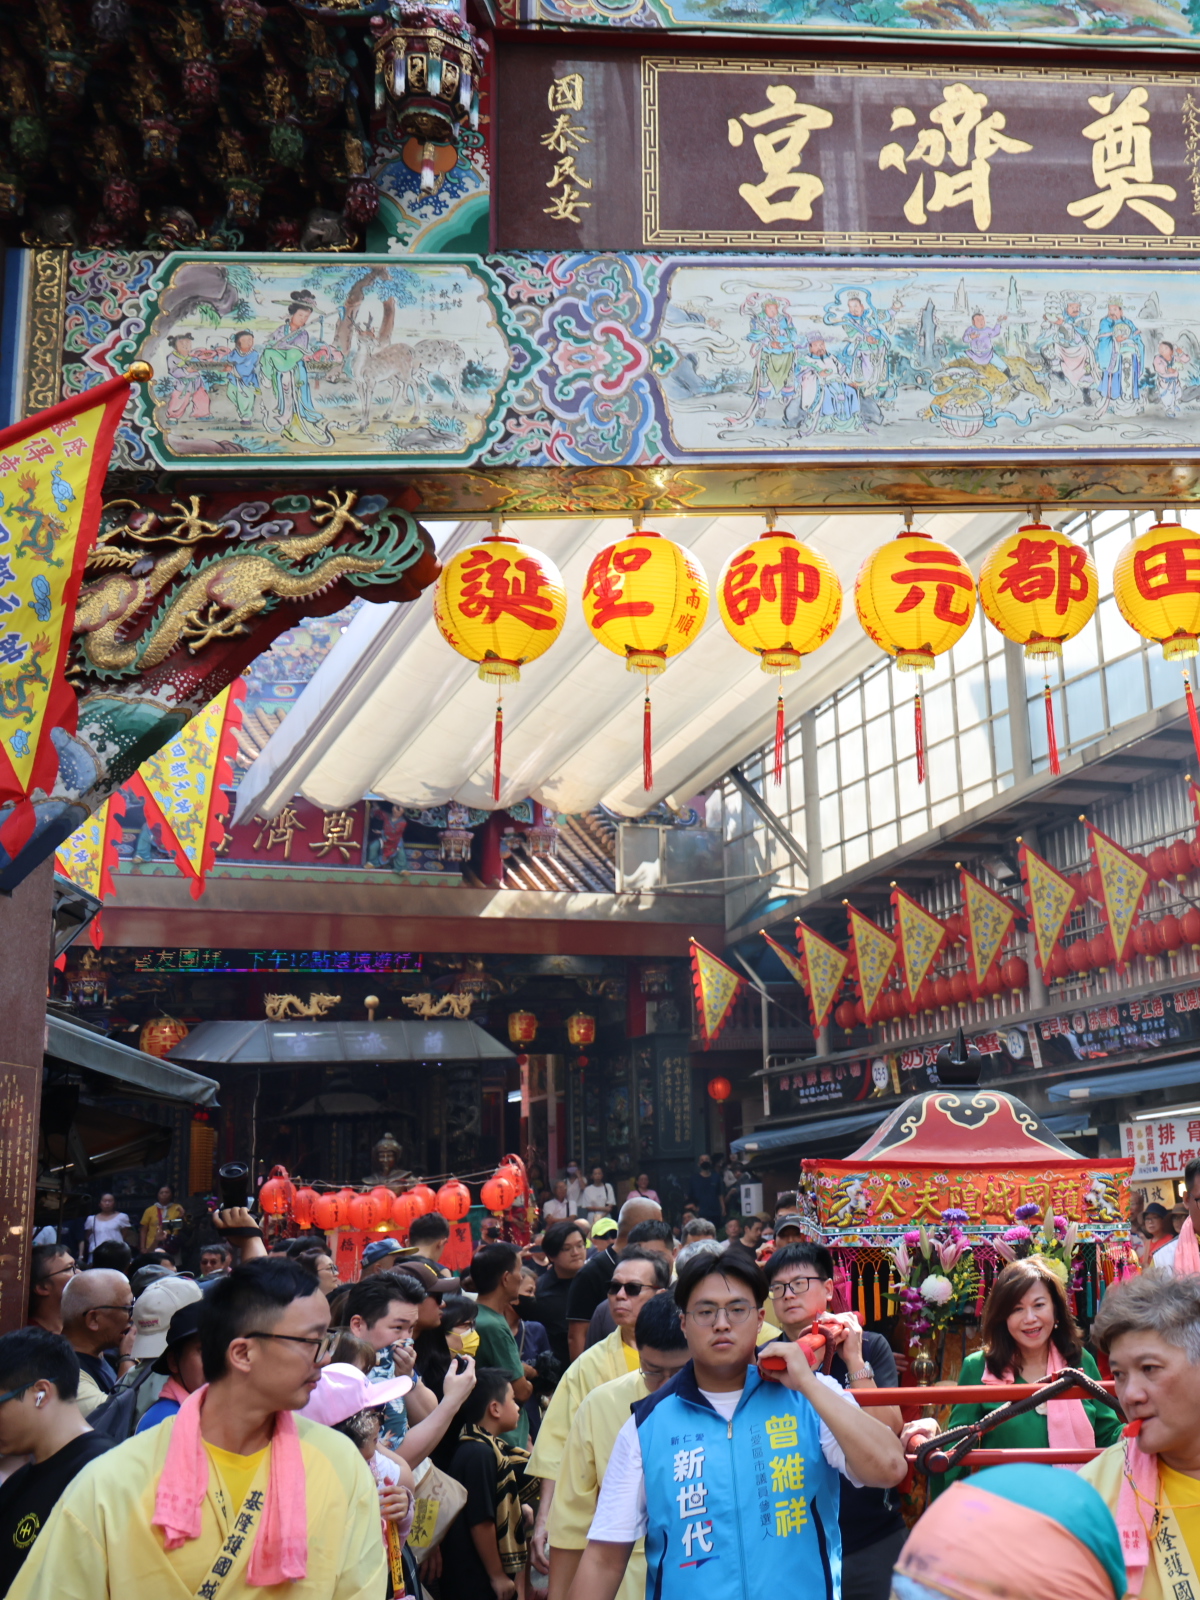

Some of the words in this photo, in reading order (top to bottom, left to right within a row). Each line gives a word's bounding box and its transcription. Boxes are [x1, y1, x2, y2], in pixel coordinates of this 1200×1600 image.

[541, 73, 592, 224] 國泰民安
[727, 83, 1177, 236] 奠濟宮
[458, 549, 558, 631] 誕
[582, 545, 655, 630] 聖
[724, 546, 822, 626] 帥
[890, 550, 973, 626] 元
[998, 538, 1089, 616] 都
[168, 742, 195, 815] 田都元帥
[876, 1178, 1082, 1221] 護國城隍夫人
[670, 1433, 705, 1446] 新仁愛
[765, 1413, 808, 1537] 曾維祥
[673, 1446, 713, 1557] 新世代
[750, 1425, 773, 1541] 仁愛區市議員參選人
